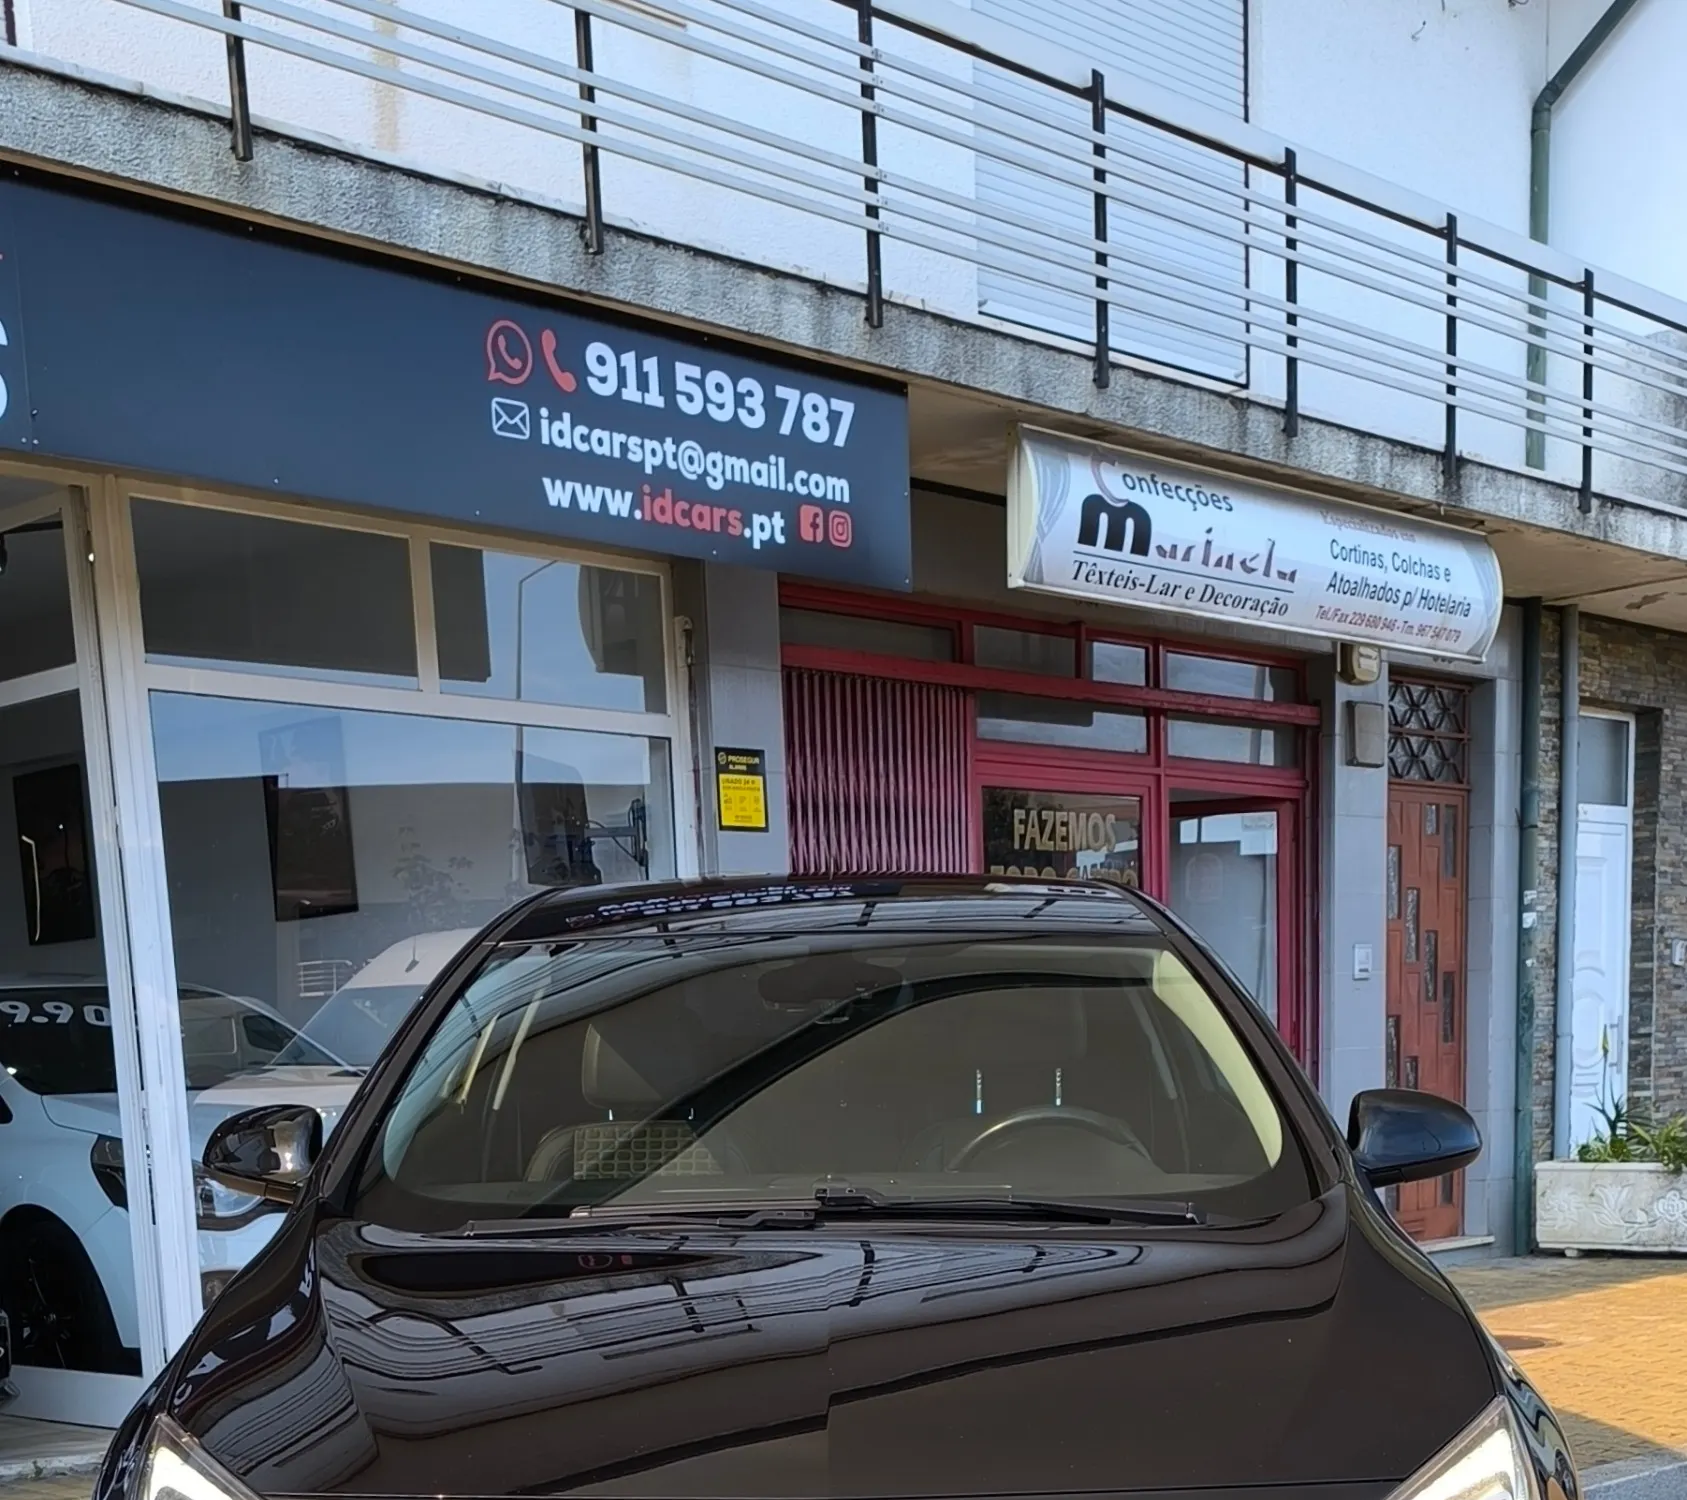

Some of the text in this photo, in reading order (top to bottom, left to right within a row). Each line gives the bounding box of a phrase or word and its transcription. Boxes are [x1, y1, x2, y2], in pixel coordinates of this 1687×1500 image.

[585, 341, 855, 447] 911 593 787
[540, 407, 850, 503] idcarspt@gmail.com
[542, 476, 786, 549] www.idcars.pt
[1072, 559, 1289, 617] Têxteis-Lar e Decoração
[1330, 538, 1451, 582] Cortinas, Colchas e
[1326, 571, 1472, 618] Atoalhados p/ Hotelaria
[1013, 808, 1117, 852] FAZEMOS
